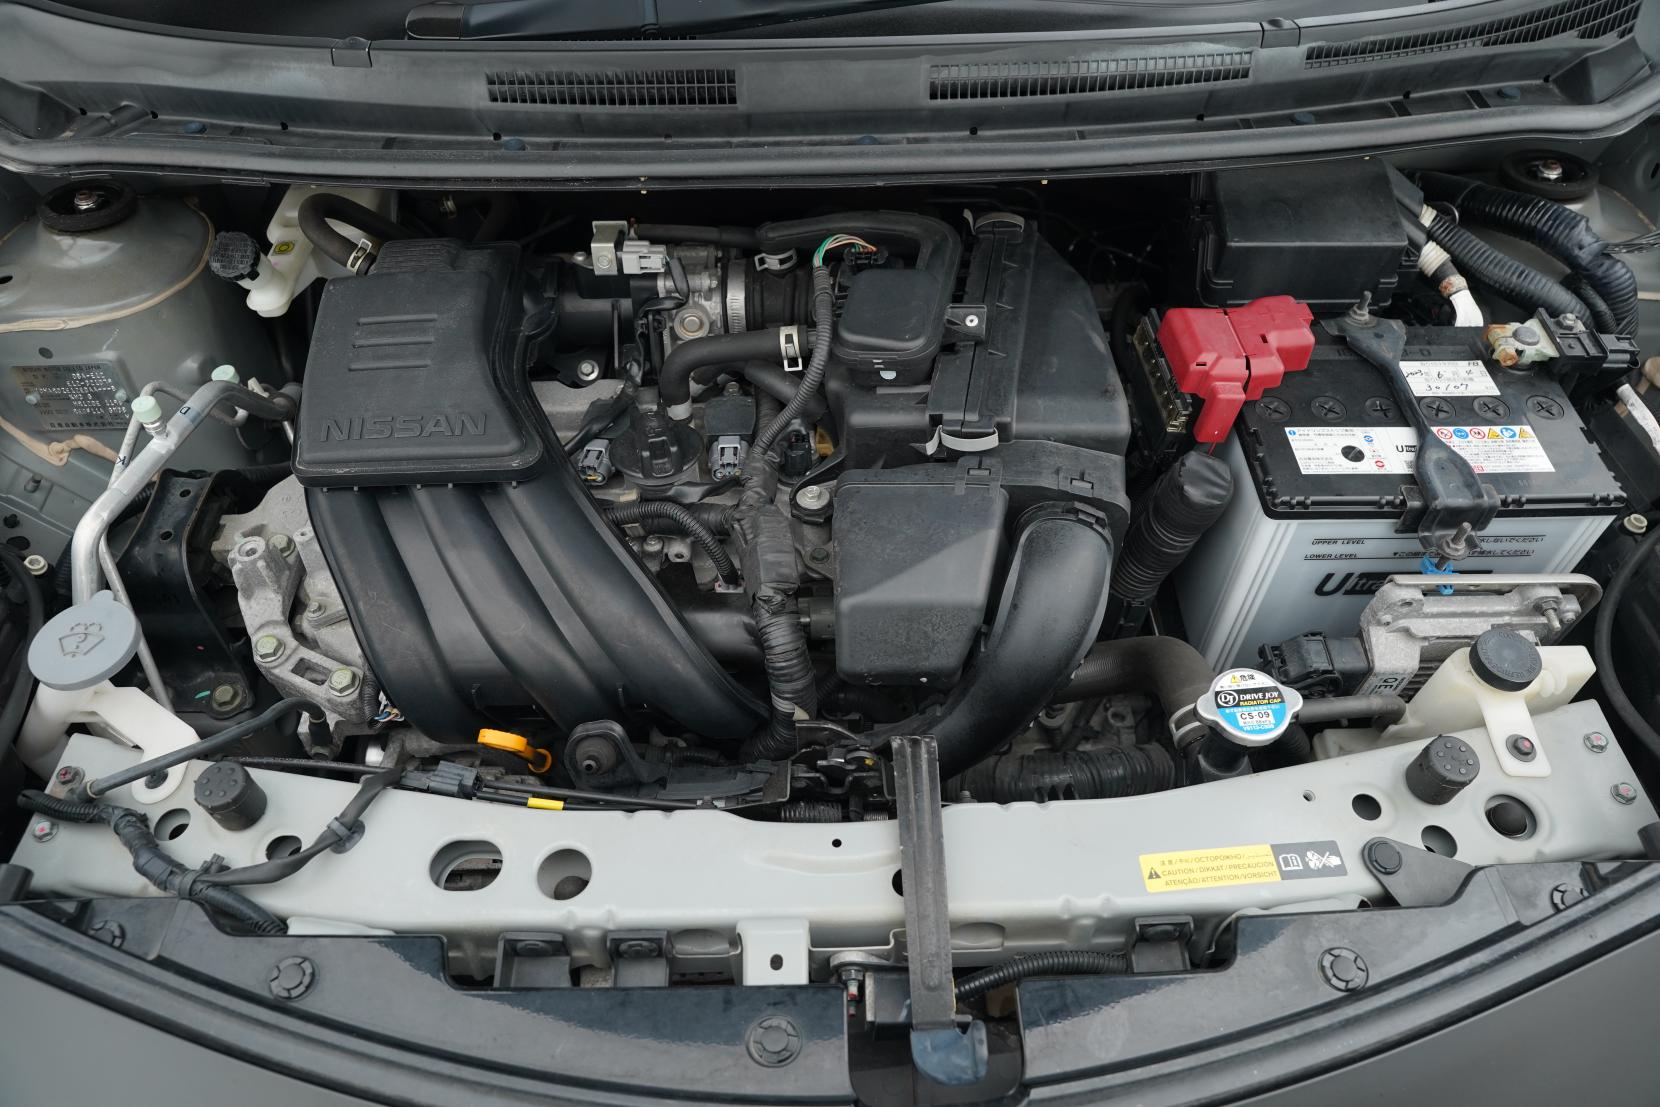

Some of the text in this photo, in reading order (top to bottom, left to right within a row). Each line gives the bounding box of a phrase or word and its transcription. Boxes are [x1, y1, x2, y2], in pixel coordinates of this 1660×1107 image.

[319, 412, 487, 442] NISSAN
[1240, 691, 1279, 701] DRIVE JOY
[1240, 711, 1271, 720] CS-09
[1161, 868, 1195, 876] CAUTION
